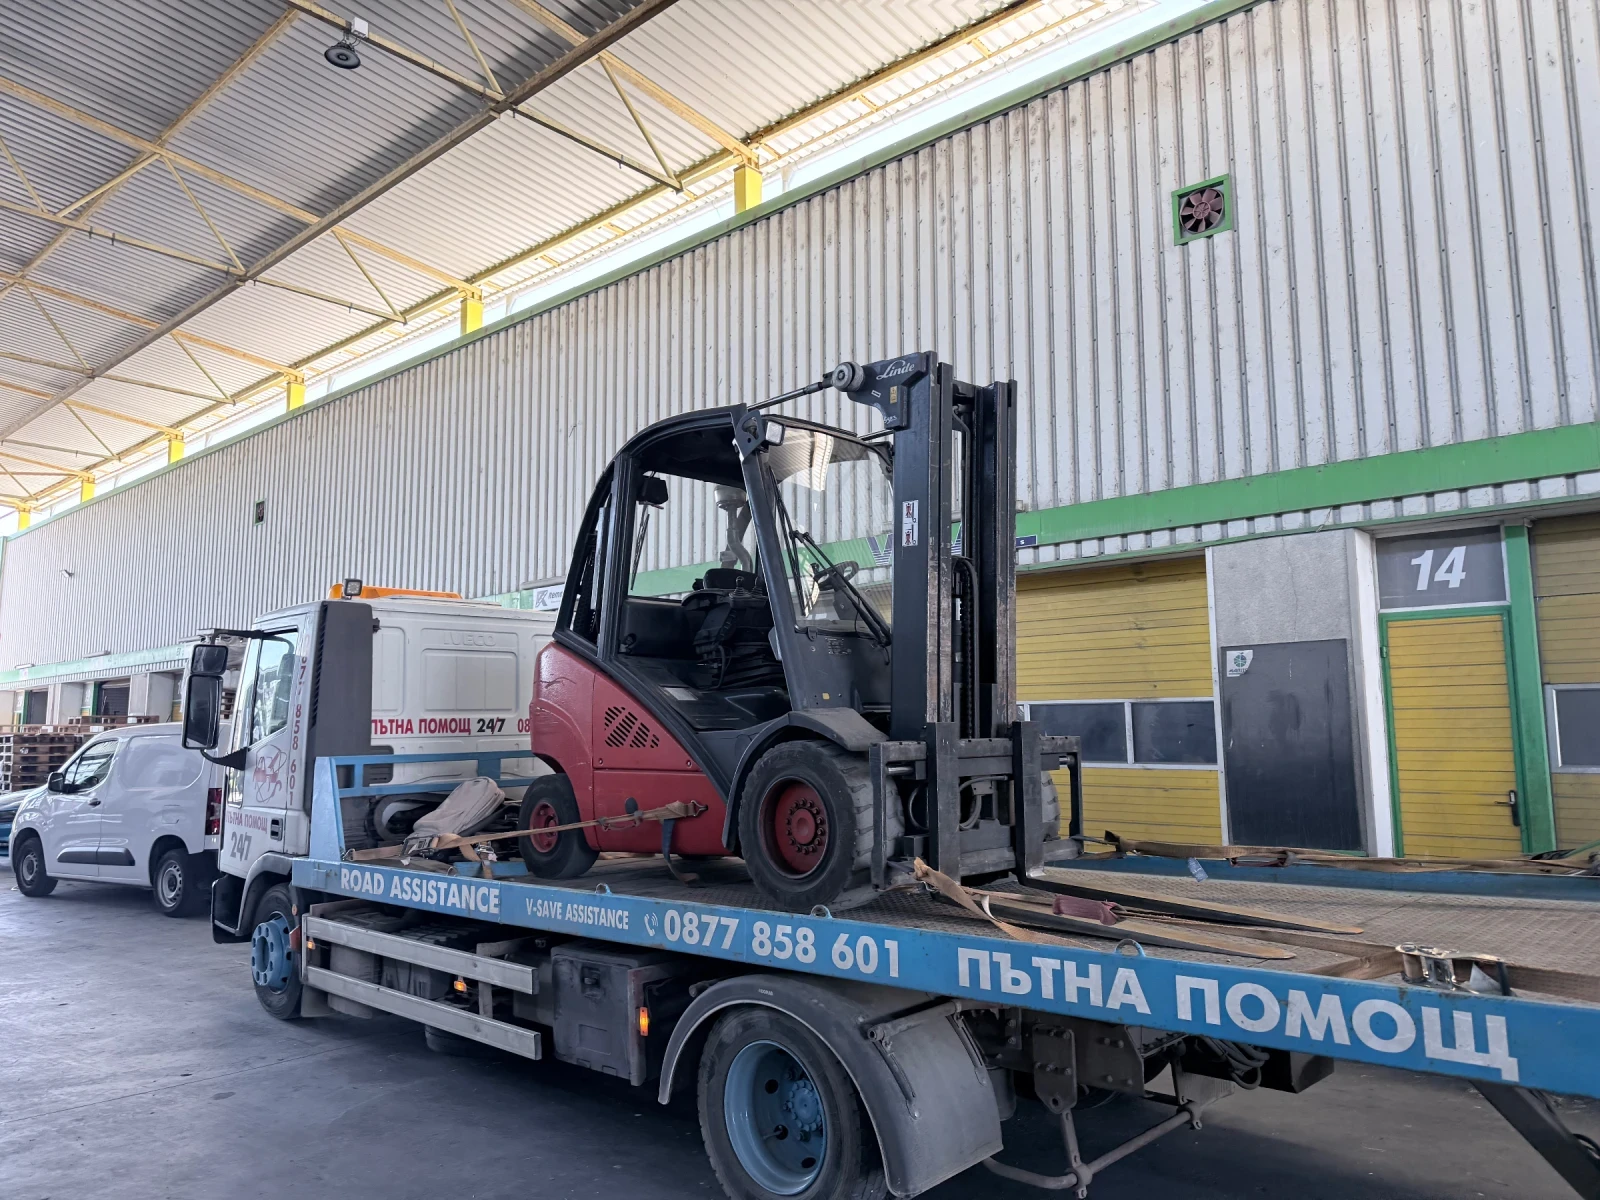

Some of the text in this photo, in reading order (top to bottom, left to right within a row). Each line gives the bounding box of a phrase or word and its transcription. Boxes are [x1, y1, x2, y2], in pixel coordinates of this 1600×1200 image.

[876, 360, 915, 380] Linde
[1410, 545, 1467, 591] 14
[443, 632, 496, 647] IVECO
[292, 703, 302, 751] 858
[418, 717, 471, 735] ПОМОЩ
[476, 716, 506, 735] 24/7
[289, 758, 297, 806] 601
[230, 831, 253, 862] 24/7
[244, 813, 268, 834] ПОМОЩ
[340, 867, 499, 914] ROAD ASSISTANCE
[526, 898, 899, 978] V-SAVE ASSISTANCE 0877 858 601
[957, 947, 1519, 1082] ПЪТНА ПОМОЩ
